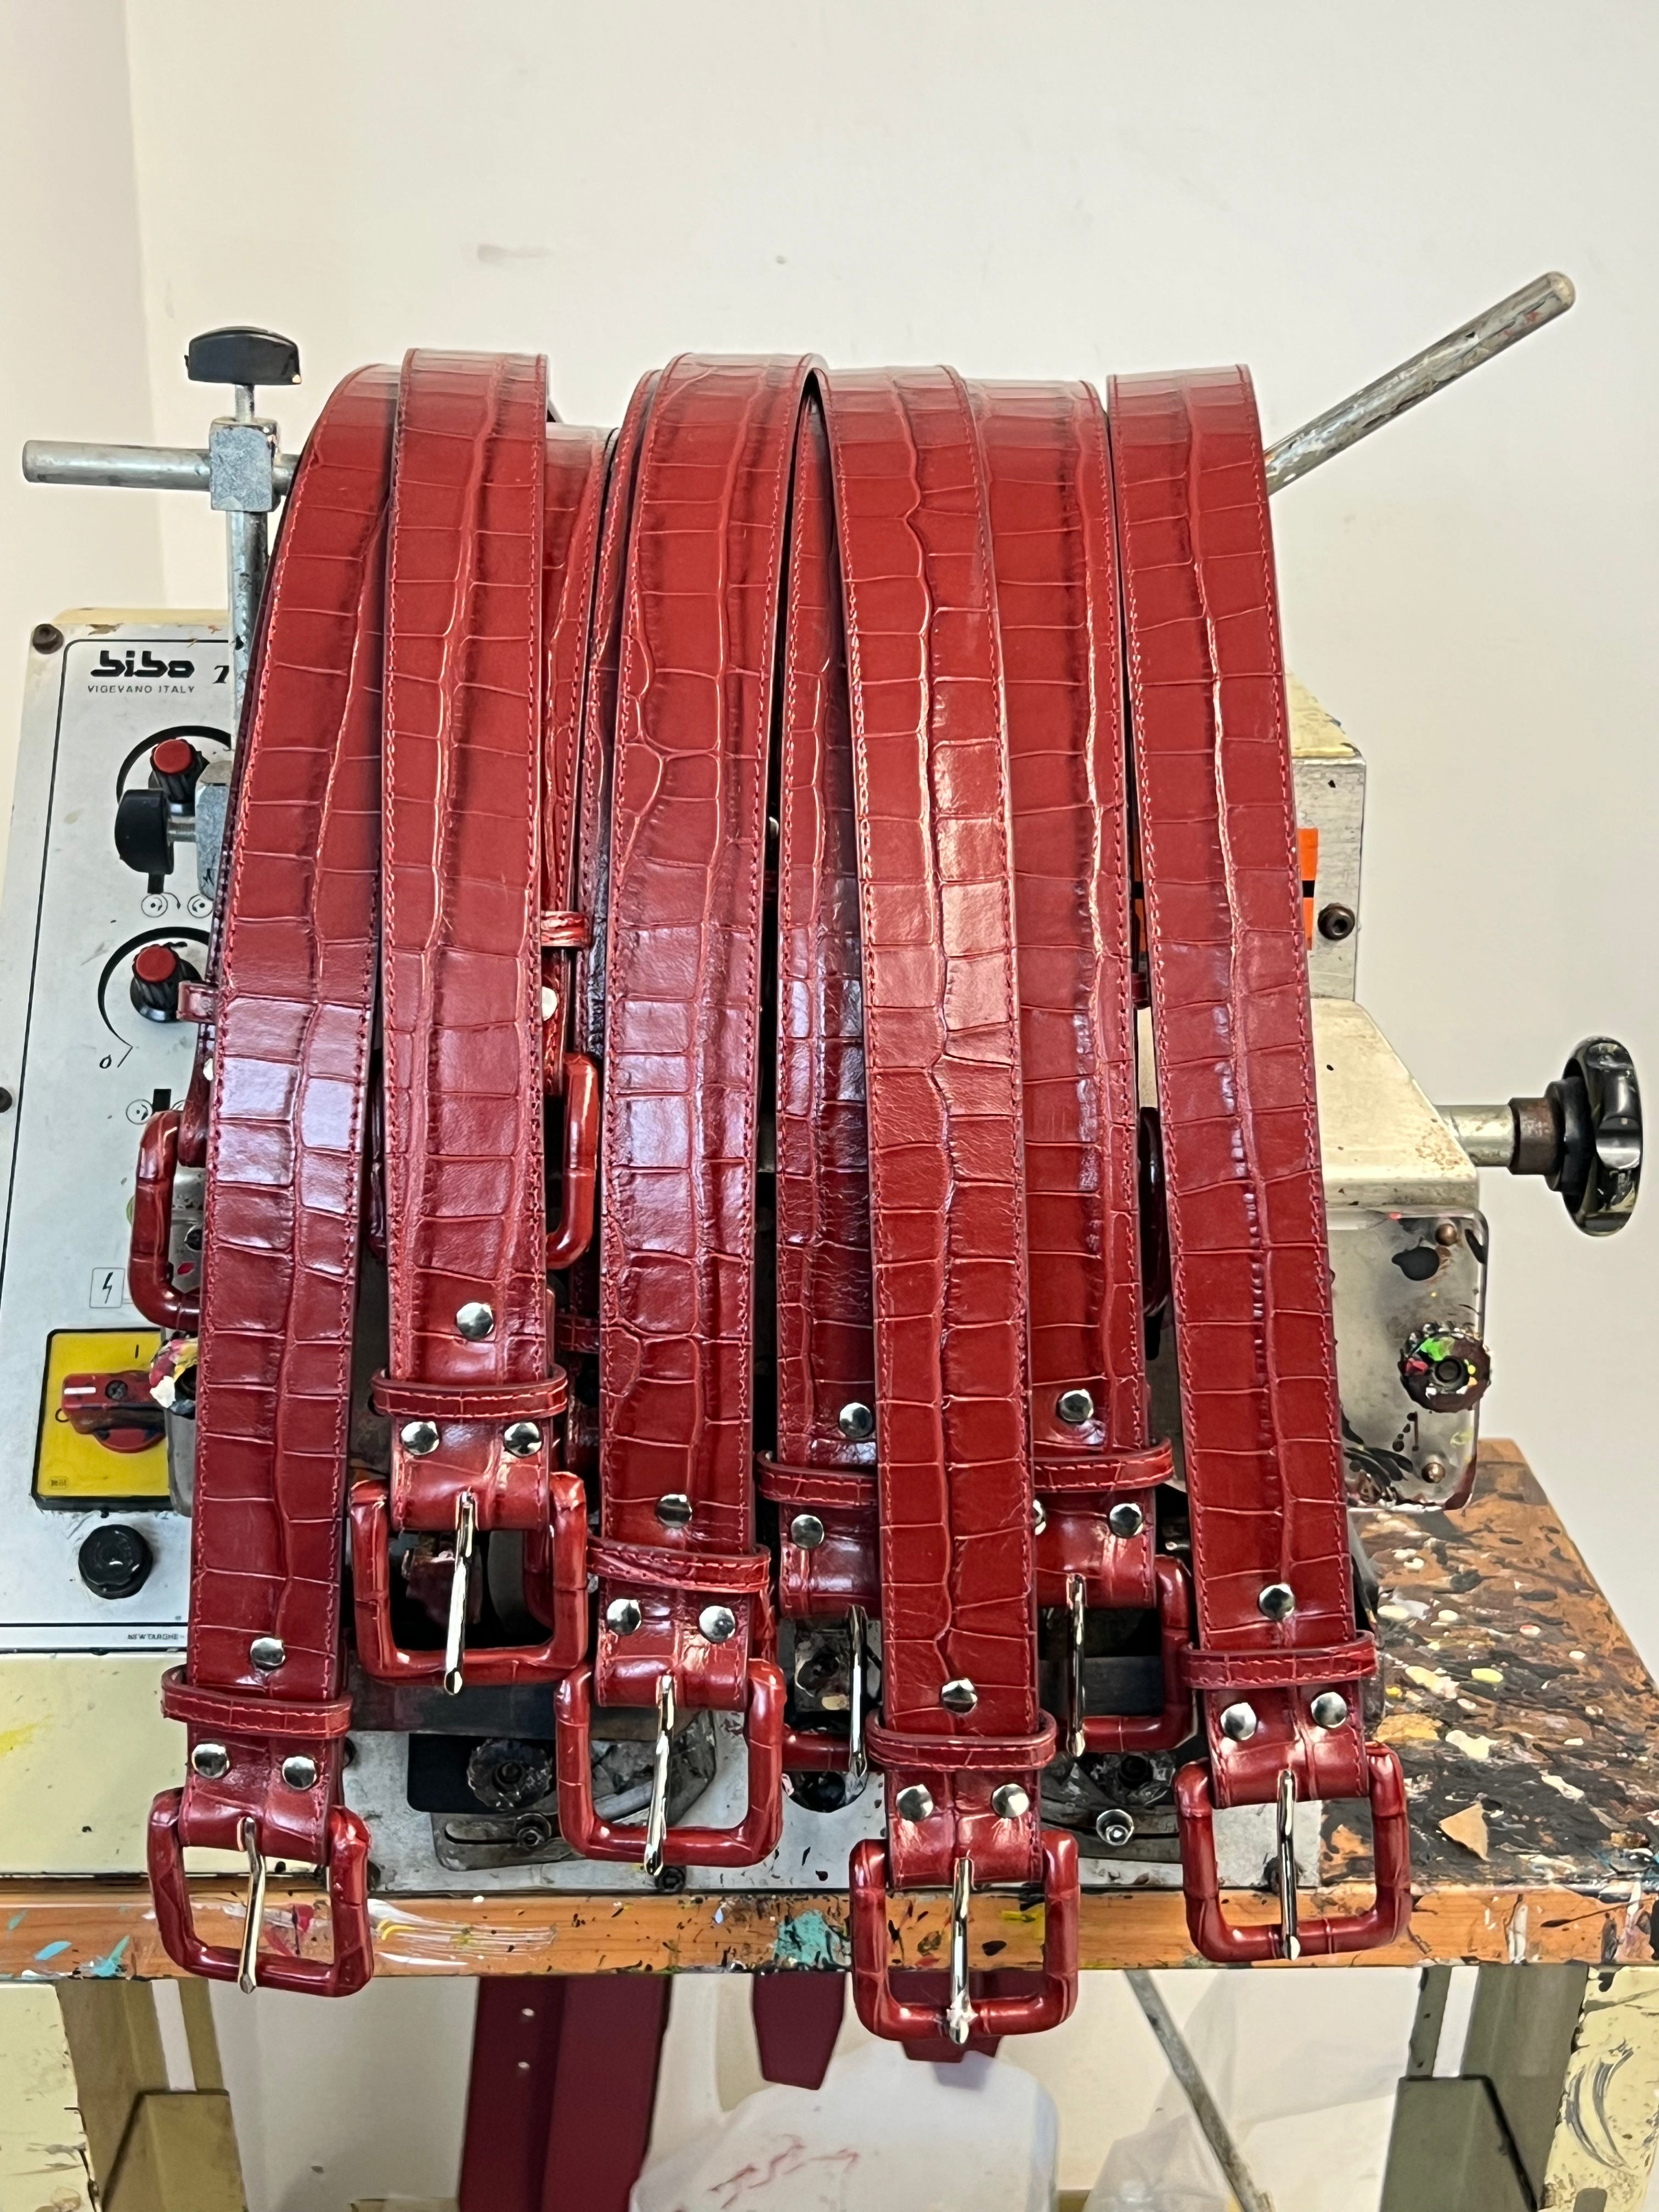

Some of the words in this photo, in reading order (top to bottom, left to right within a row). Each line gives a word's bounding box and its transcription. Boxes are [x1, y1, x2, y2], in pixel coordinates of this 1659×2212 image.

[90, 650, 195, 678] bibo
[88, 685, 153, 693] VIGEVANO
[158, 686, 195, 694] ITALY
